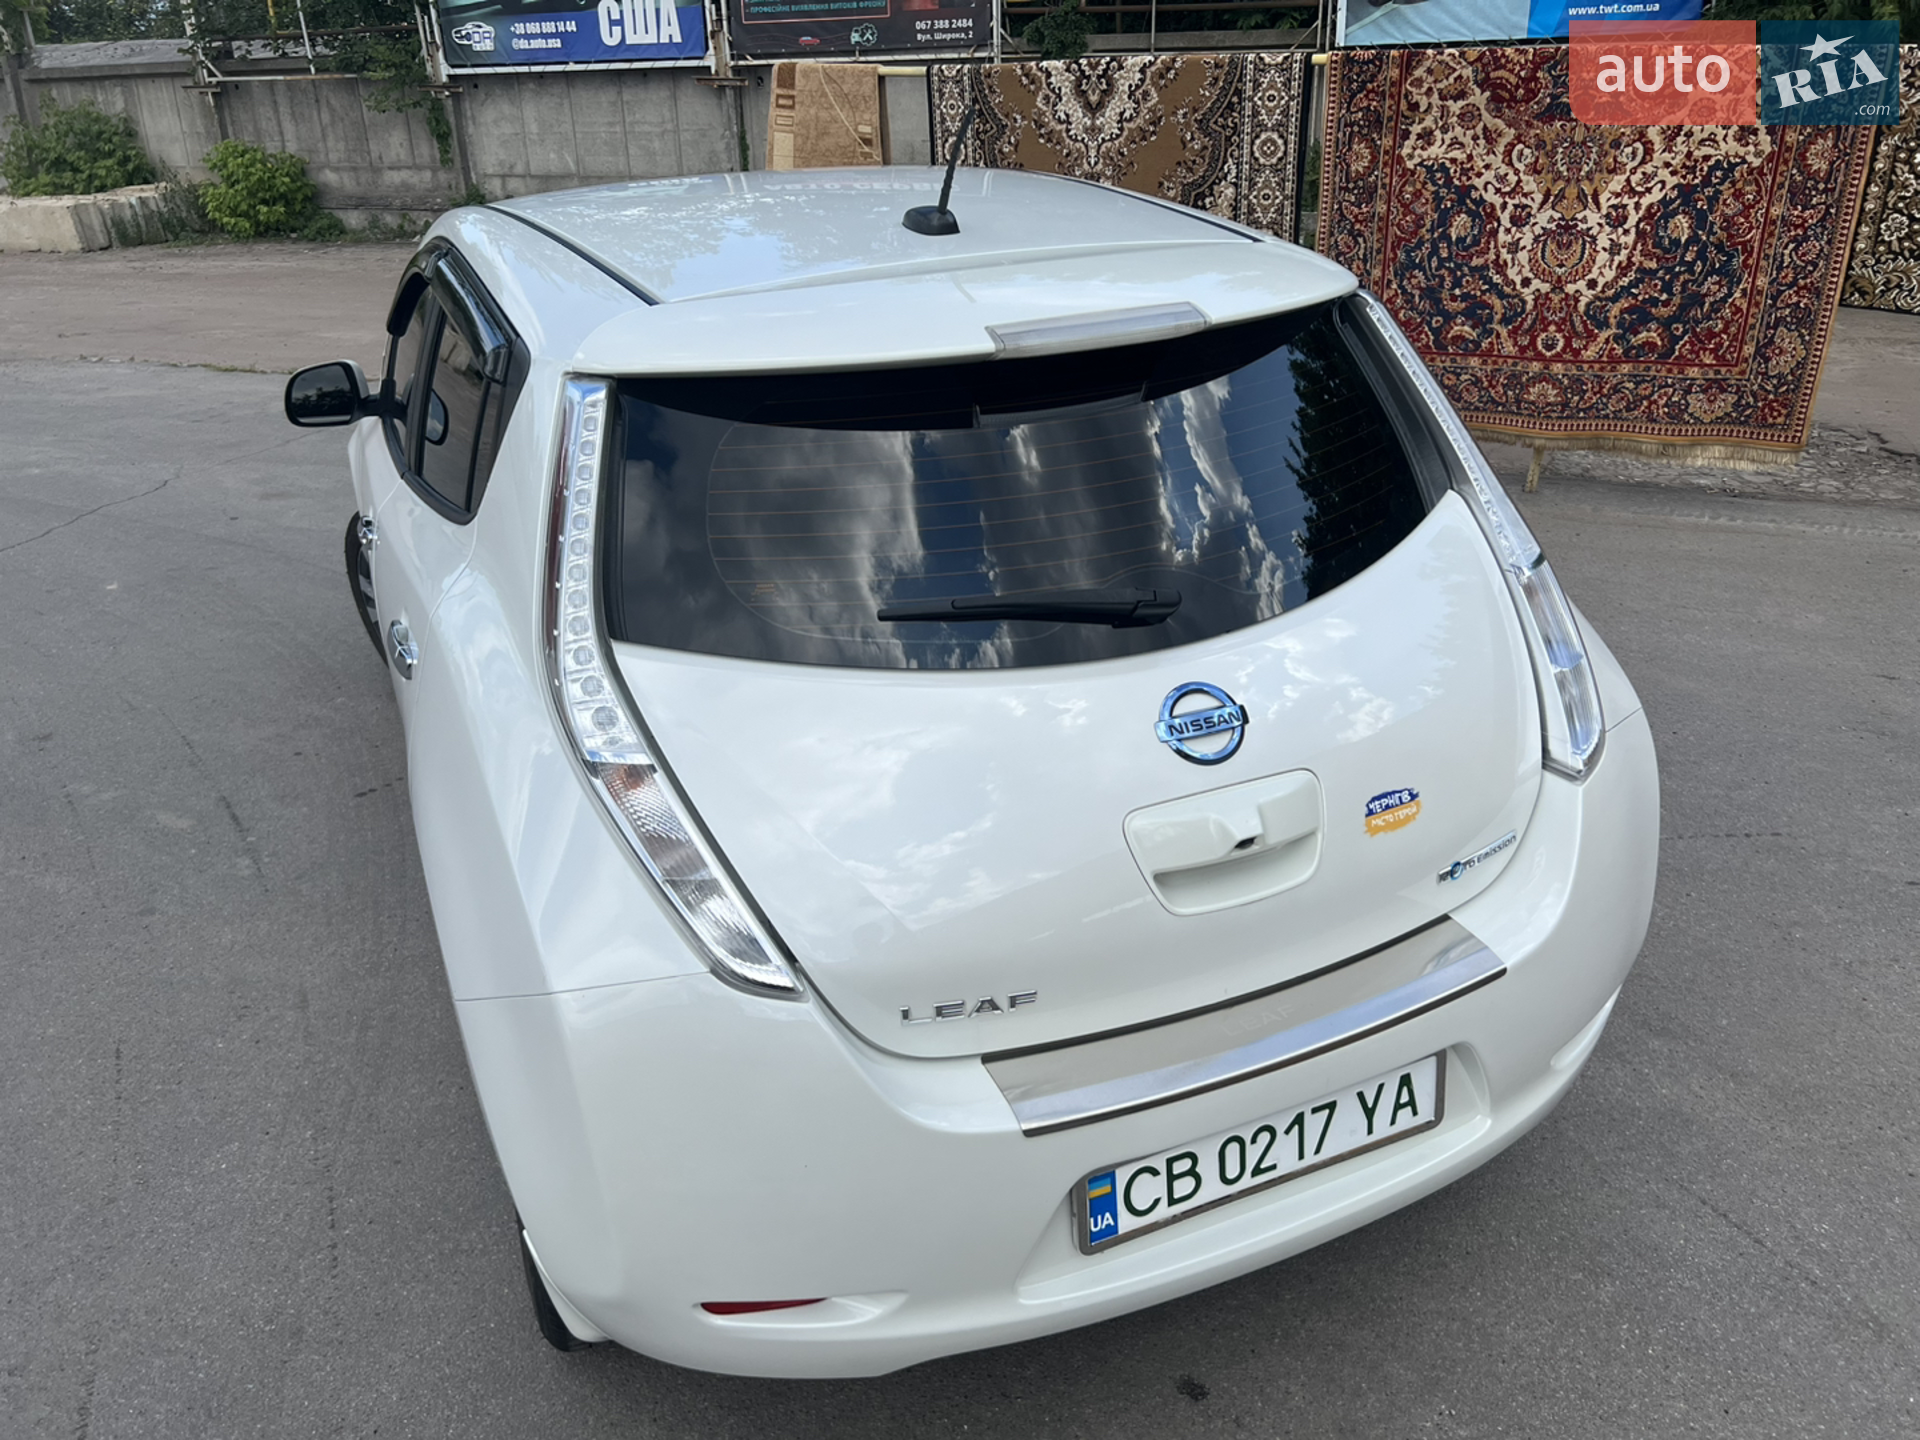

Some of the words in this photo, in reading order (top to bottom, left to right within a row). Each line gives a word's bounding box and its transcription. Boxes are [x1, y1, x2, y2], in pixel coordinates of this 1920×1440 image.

[1568, 3, 1660, 16] www.twt.com.ua
[597, 0, 683, 46] США
[915, 20, 931, 30] 067
[933, 19, 949, 29] 388
[951, 18, 973, 28] 2484
[968, 30, 973, 38] 2
[1168, 710, 1241, 737] NISSAN
[900, 989, 1037, 1026] LEAF
[1123, 1151, 1202, 1217] CB
[1218, 1100, 1338, 1186] 0217
[1356, 1072, 1419, 1137] YA
[1090, 1212, 1115, 1232] UA
